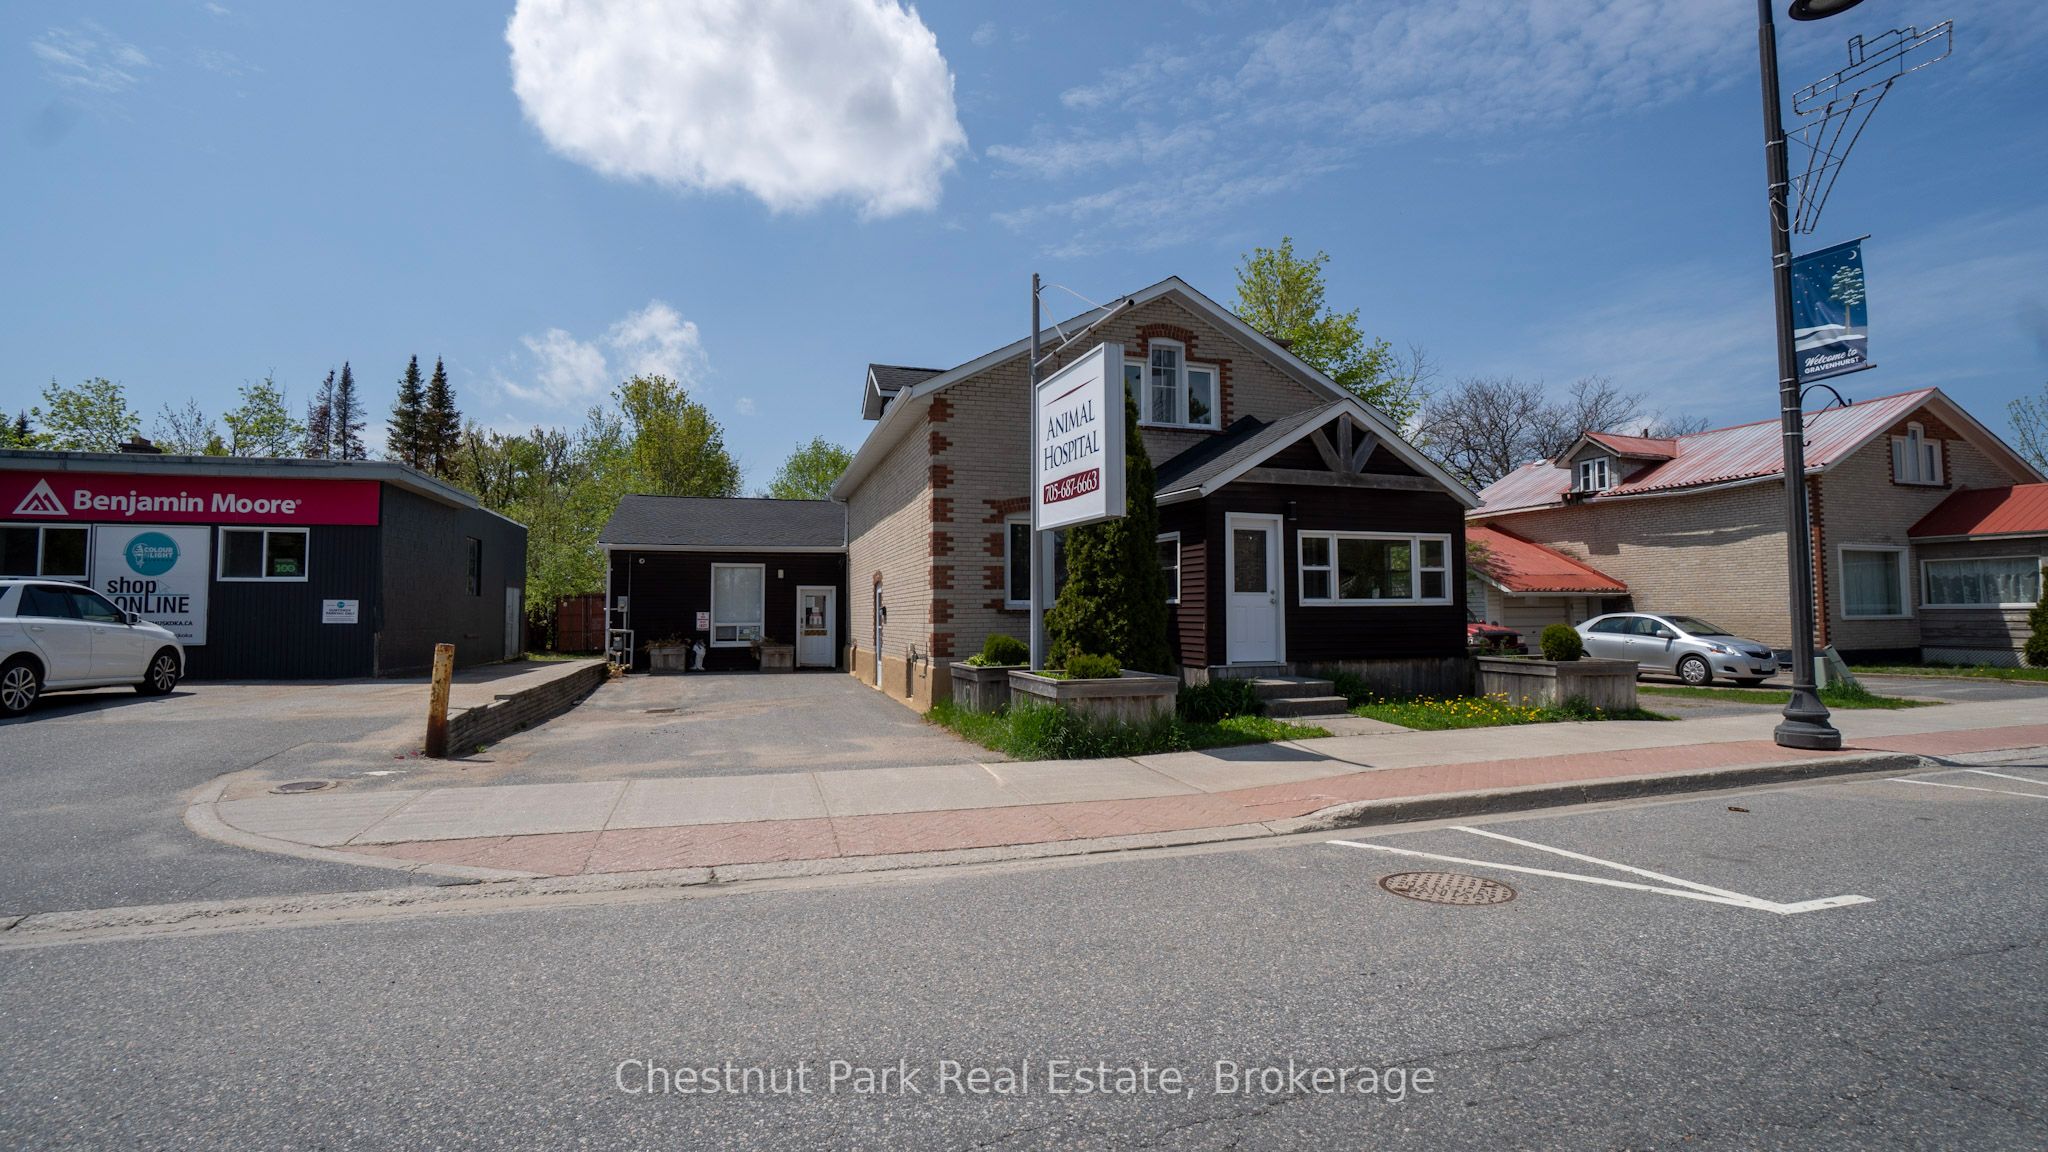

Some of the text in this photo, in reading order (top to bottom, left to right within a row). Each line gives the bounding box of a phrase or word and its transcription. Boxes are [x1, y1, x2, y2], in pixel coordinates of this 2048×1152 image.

[1804, 356, 1860, 374] GRAVENHURST
[1805, 348, 1858, 367] Welcome to
[1046, 400, 1096, 441] ANIMAL
[1044, 430, 1100, 471] HOSPITAL
[1045, 471, 1098, 503] 705-687-6663
[73, 489, 204, 517] Benjamin
[107, 576, 157, 600] shop
[115, 596, 190, 614] ONLINE
